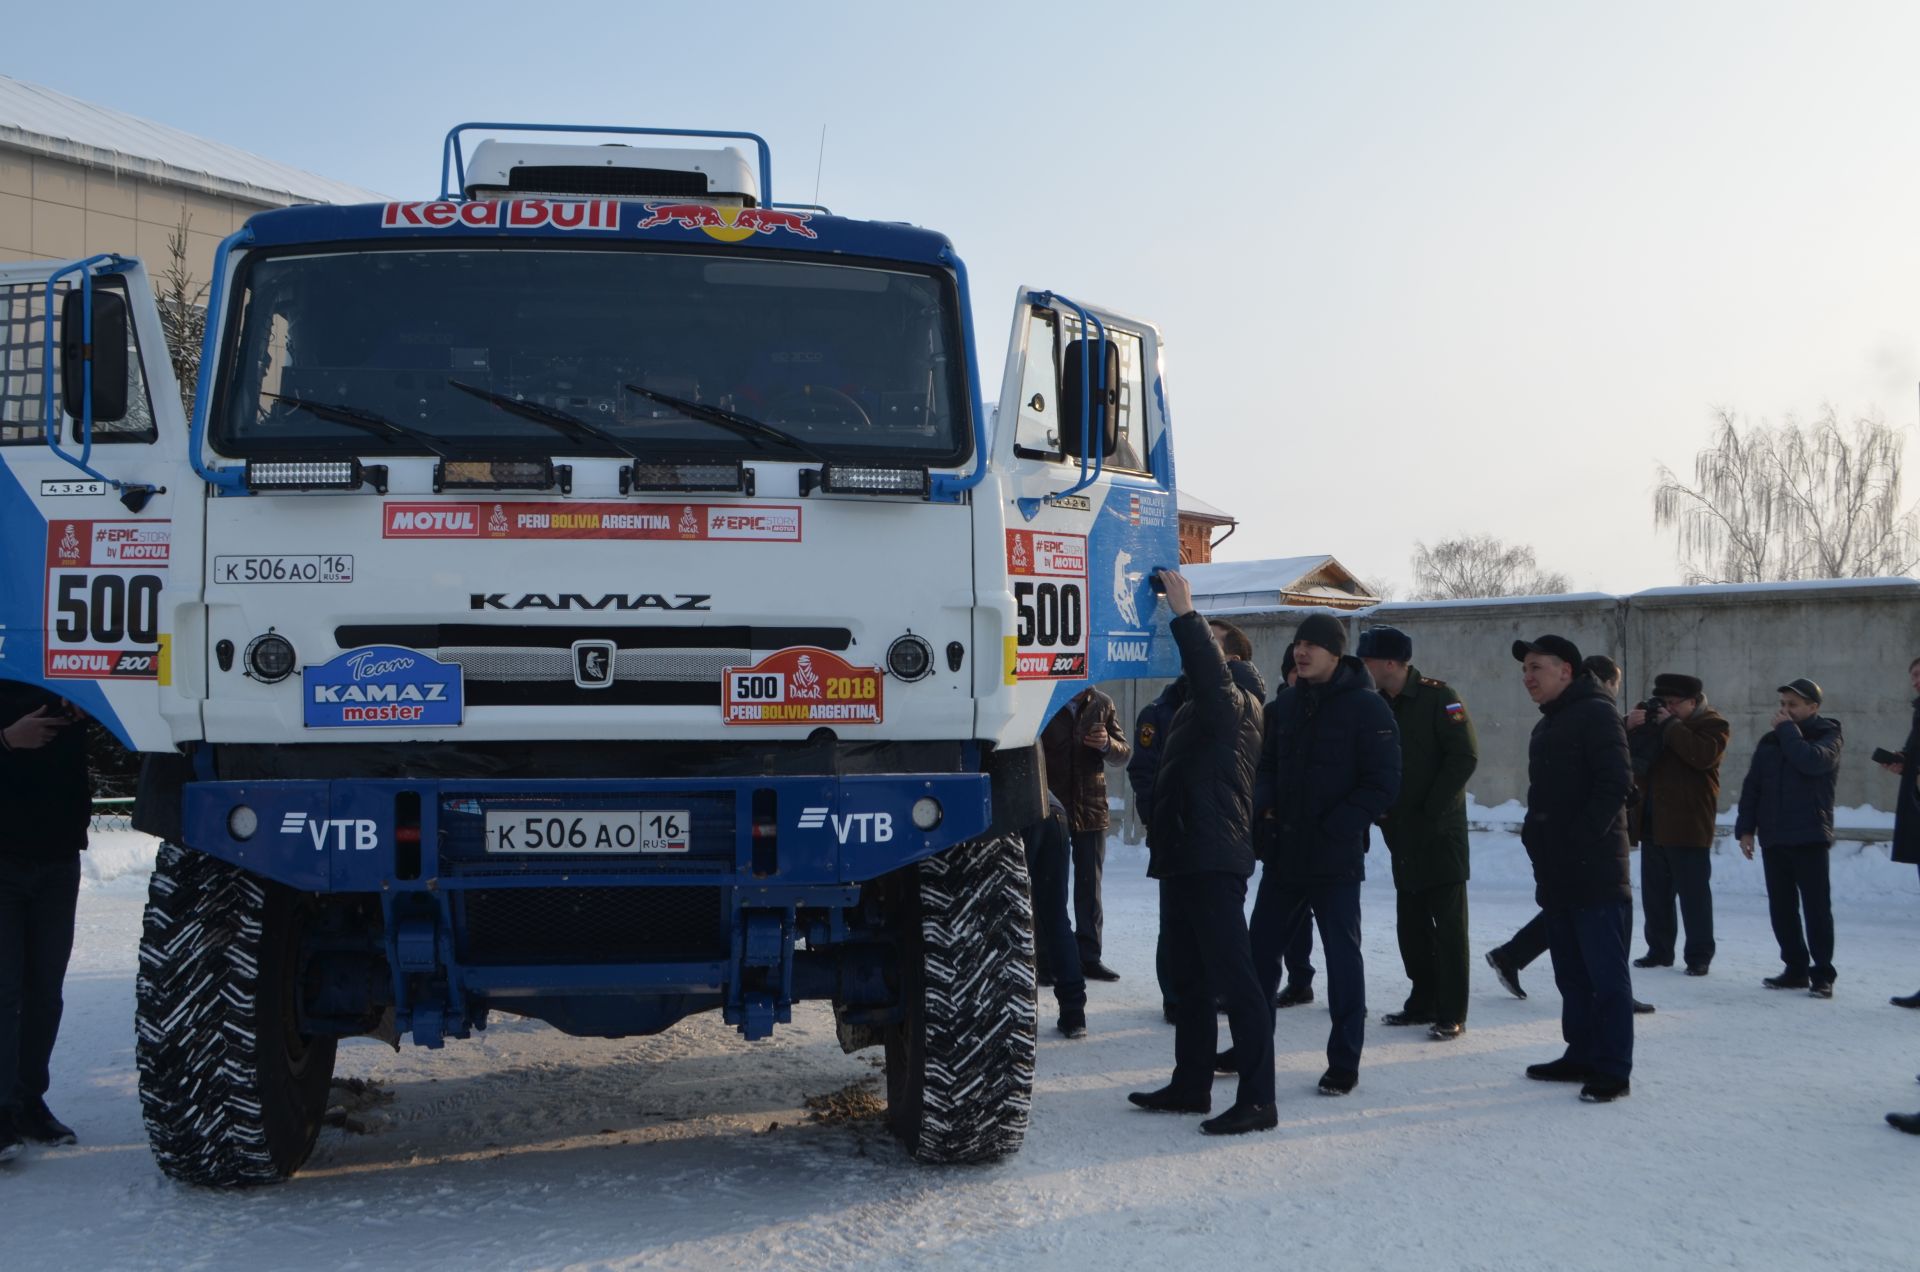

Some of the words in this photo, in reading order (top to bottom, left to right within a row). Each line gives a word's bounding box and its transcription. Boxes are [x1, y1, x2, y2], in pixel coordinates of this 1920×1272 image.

[509, 200, 618, 227] Bull
[49, 484, 97, 493] 4326
[391, 512, 474, 529] MOTUL
[517, 514, 550, 528] PERU
[551, 514, 600, 529] BOLIVIA
[601, 515, 671, 529] ARGENTINA
[107, 546, 117, 558] by
[122, 546, 168, 558] MOTUL
[324, 557, 345, 573] 16
[1054, 557, 1083, 569] MOTUL
[56, 574, 163, 643] 500
[469, 593, 712, 610] KAMAZ
[1015, 582, 1082, 646] 500
[1108, 642, 1148, 661] KAMAZ
[52, 655, 110, 670] MOTUL
[347, 651, 414, 681] Team
[315, 684, 447, 703] KAMAZ
[737, 676, 778, 699] 500
[789, 684, 822, 699] DAKAR
[826, 677, 876, 699] 2018
[343, 703, 425, 721] master
[309, 819, 378, 851] VTB
[650, 815, 680, 839] 16
[831, 812, 894, 844] VTB
[643, 840, 667, 848] RUS
